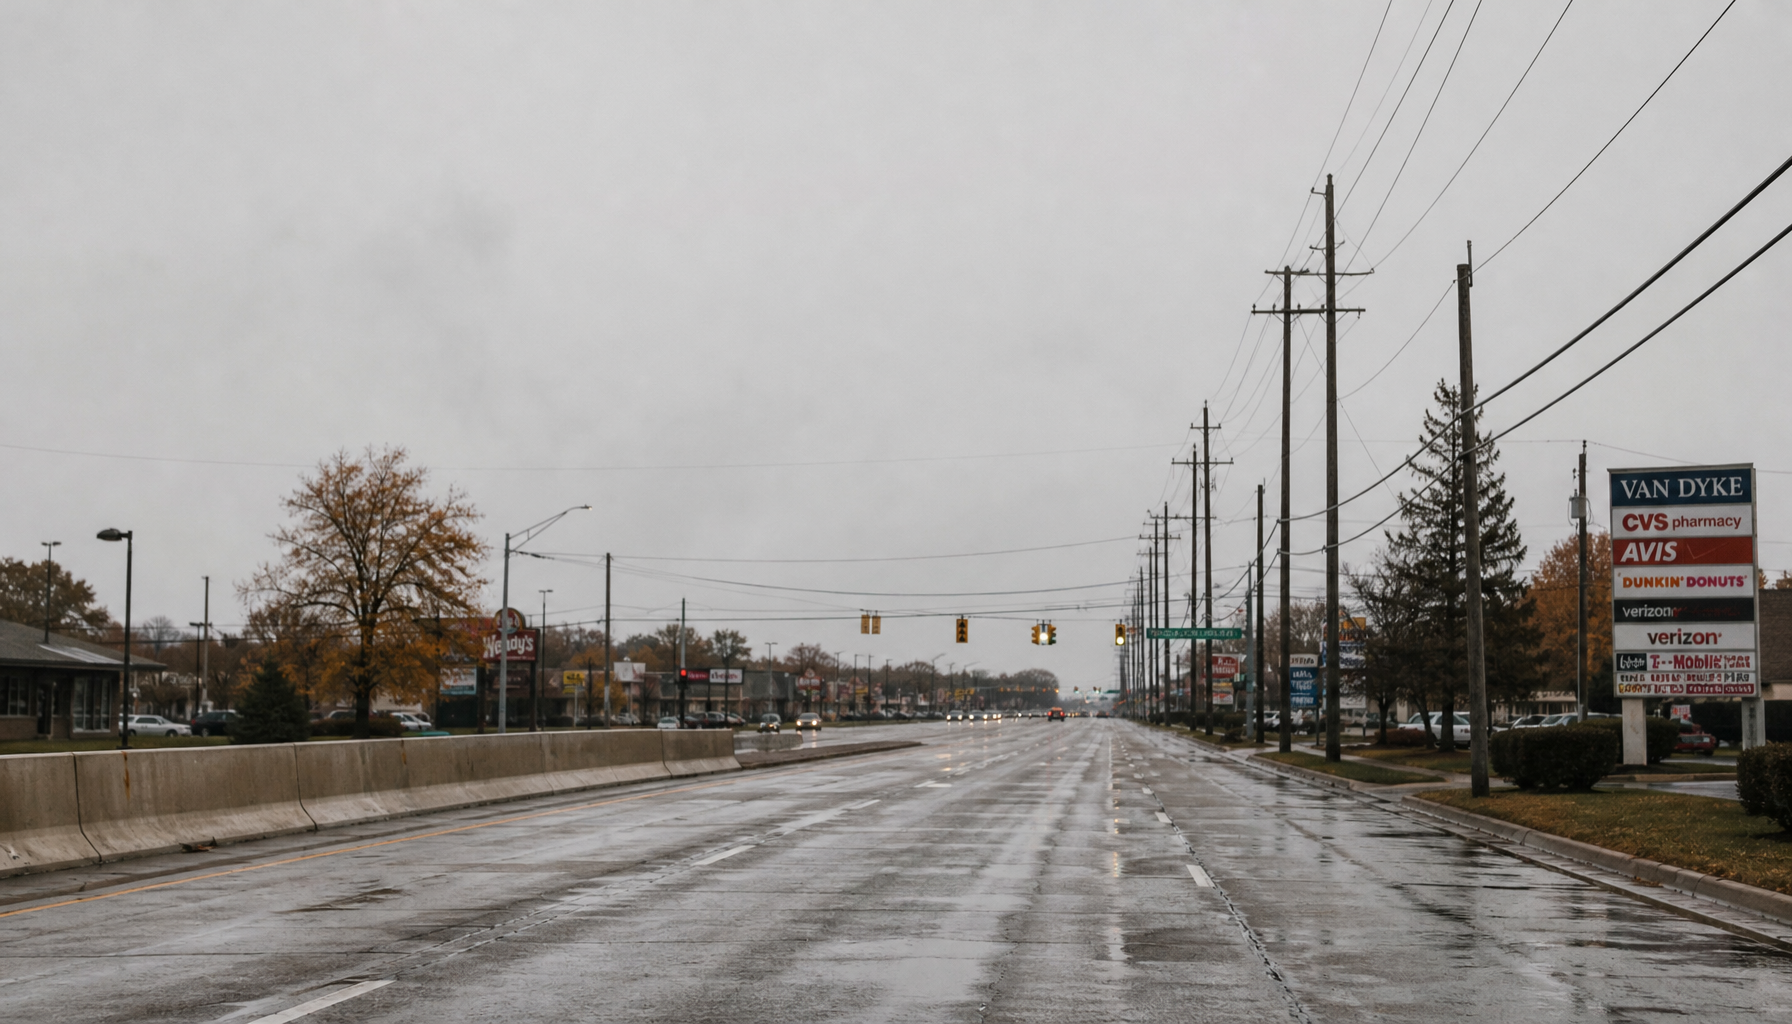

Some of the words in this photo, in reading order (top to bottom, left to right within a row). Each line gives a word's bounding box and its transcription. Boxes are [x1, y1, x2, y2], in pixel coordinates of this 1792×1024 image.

[1620, 478, 1670, 499] VAN
[1677, 476, 1744, 498] DYKE
[1622, 512, 1669, 532] CVS
[1672, 515, 1742, 531] pharmacy
[1620, 540, 1678, 563] AVIS
[1622, 575, 1685, 588] DUNKIN'
[1686, 574, 1744, 588] DONUTS
[1647, 628, 1719, 645] verizon
